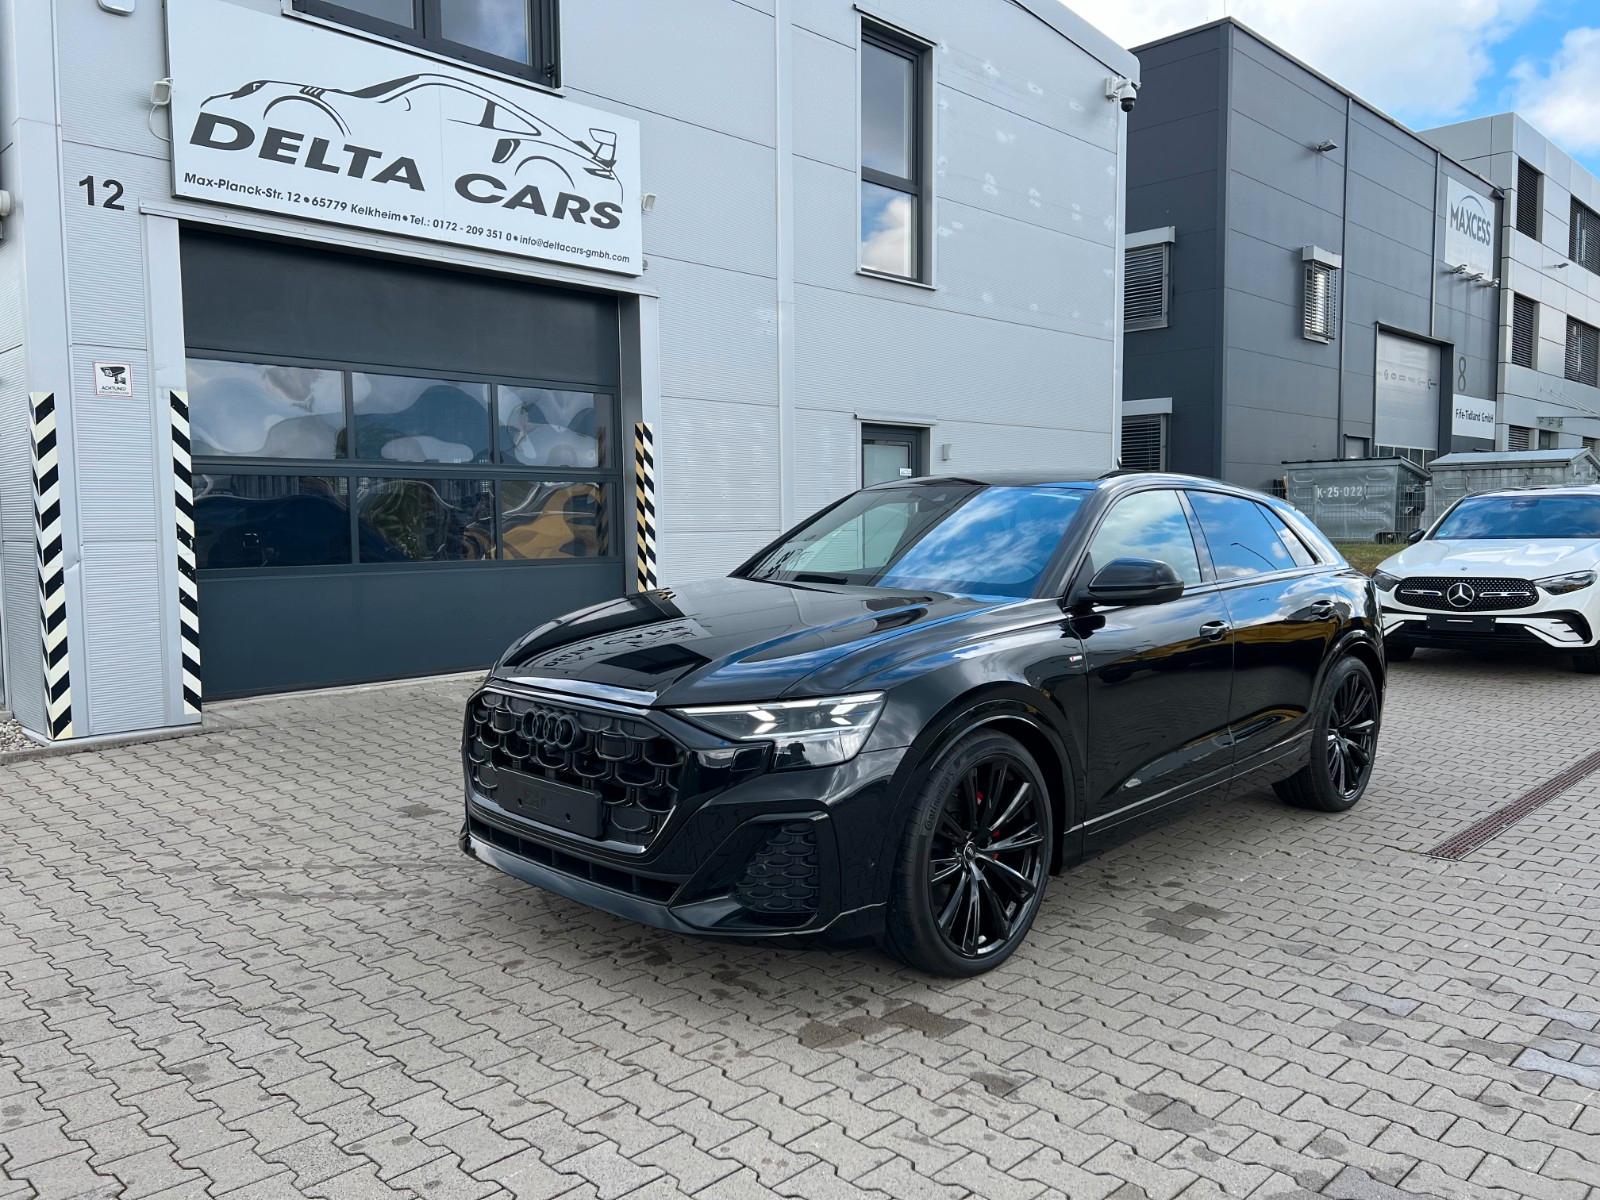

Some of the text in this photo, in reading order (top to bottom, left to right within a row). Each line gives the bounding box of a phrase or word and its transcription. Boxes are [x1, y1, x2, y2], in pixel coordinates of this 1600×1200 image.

[189, 111, 623, 229] DELTA CARS
[79, 175, 125, 211] 12
[184, 172, 284, 200] Max-Planck-Str.
[287, 191, 301, 203] 12
[311, 196, 348, 211] 65779
[350, 204, 401, 221] Kelkheim
[410, 214, 430, 227] Tel.:
[432, 219, 457, 231] 0172
[466, 225, 484, 236] 209
[486, 229, 503, 239] 351
[506, 232, 512, 241] 0
[519, 235, 630, 263] info@deltacars-gmbh.com
[1450, 201, 1491, 246] MAXCESS
[1458, 356, 1466, 392] 8
[1317, 486, 1363, 498] K-25-022
